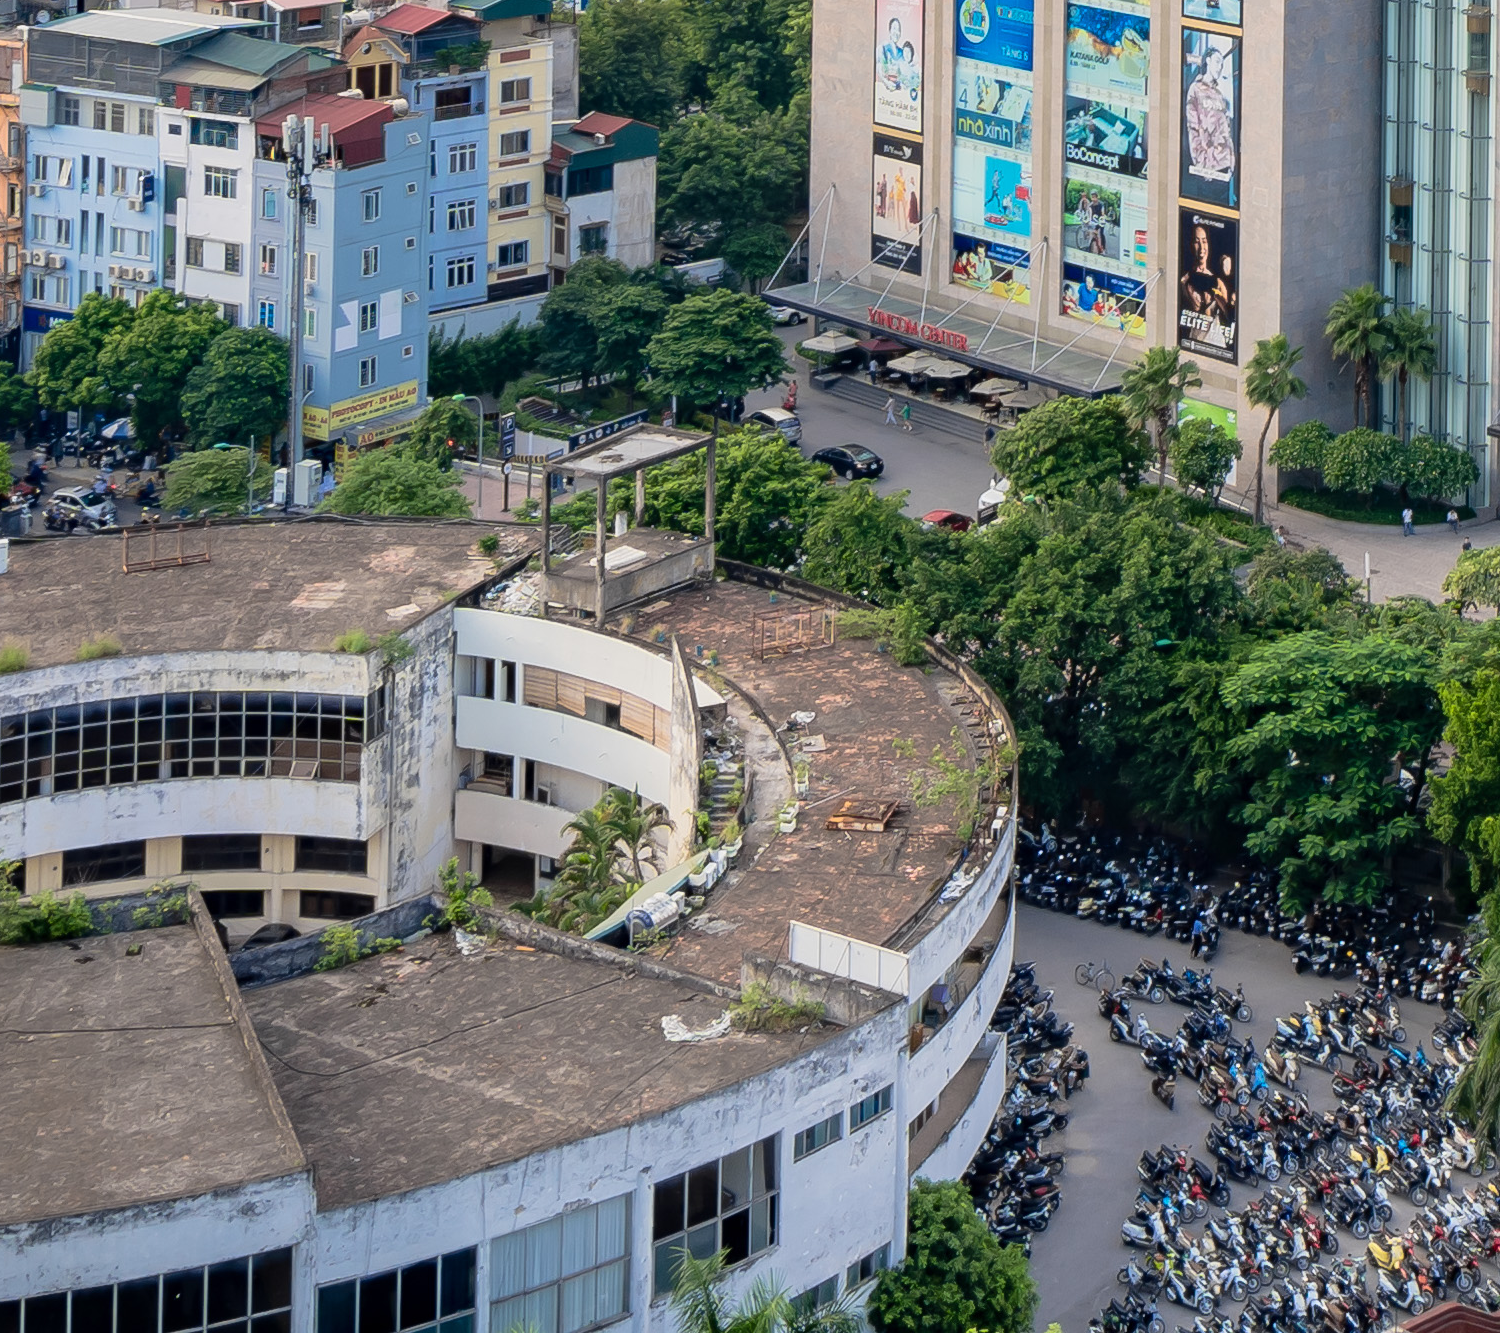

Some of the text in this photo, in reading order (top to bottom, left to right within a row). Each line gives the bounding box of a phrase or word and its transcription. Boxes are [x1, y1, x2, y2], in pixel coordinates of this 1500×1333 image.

[959, 88, 968, 109] 4
[984, 120, 1011, 142] xinh
[1066, 144, 1120, 170] BoConcept
[867, 307, 968, 351] VINCOM CENTER
[1180, 315, 1209, 331] ELITE
[332, 400, 375, 418] PHOTOCOPY
[389, 389, 404, 402] MÀU
